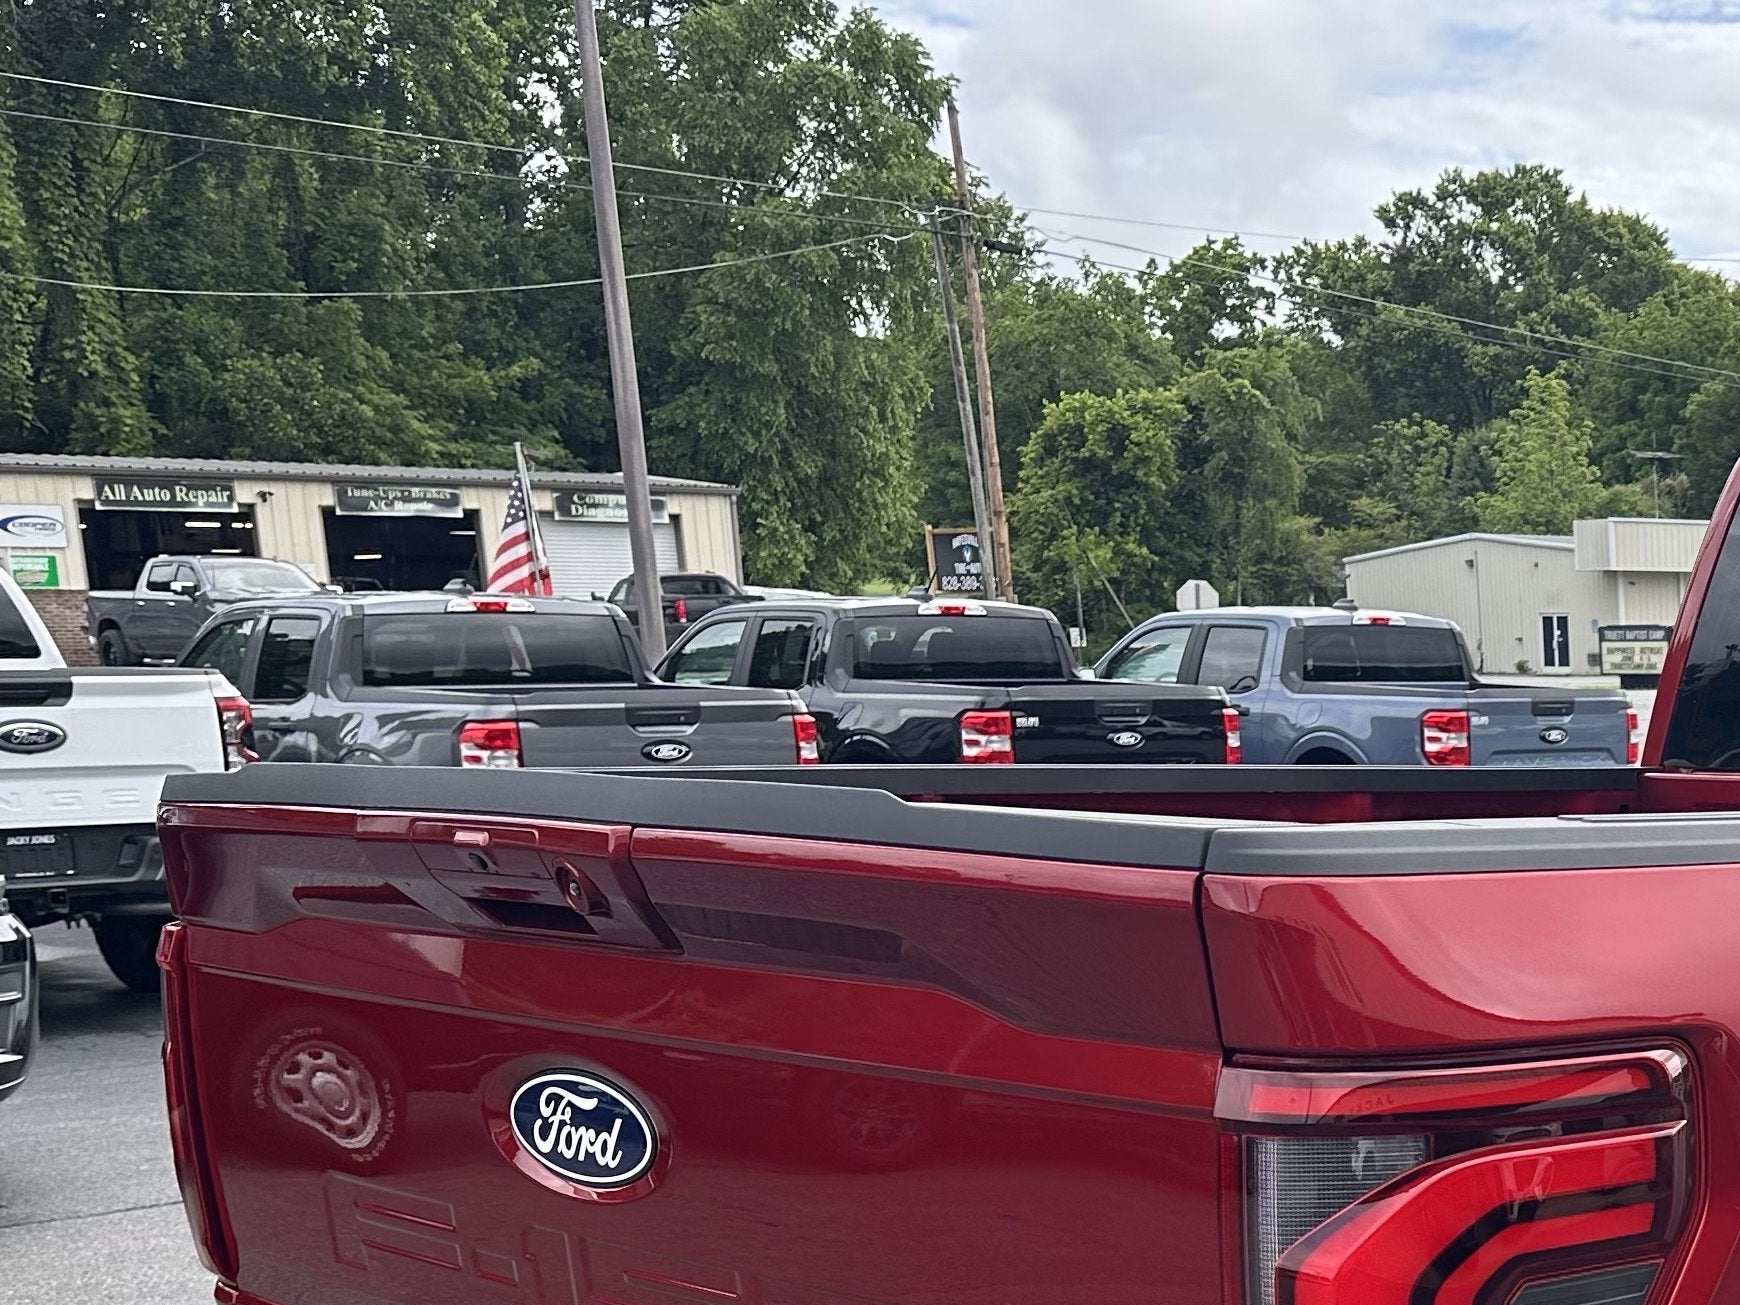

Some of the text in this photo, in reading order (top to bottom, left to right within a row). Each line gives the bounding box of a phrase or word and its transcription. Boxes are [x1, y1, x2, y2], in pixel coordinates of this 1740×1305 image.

[101, 484, 231, 506] All Auto Repair
[347, 487, 402, 500] Tune-Ups
[572, 491, 627, 507] Compu
[367, 500, 391, 511] A/C
[570, 504, 629, 518] Diagnos
[10, 728, 49, 744] Ford
[533, 1085, 623, 1169] Ford
